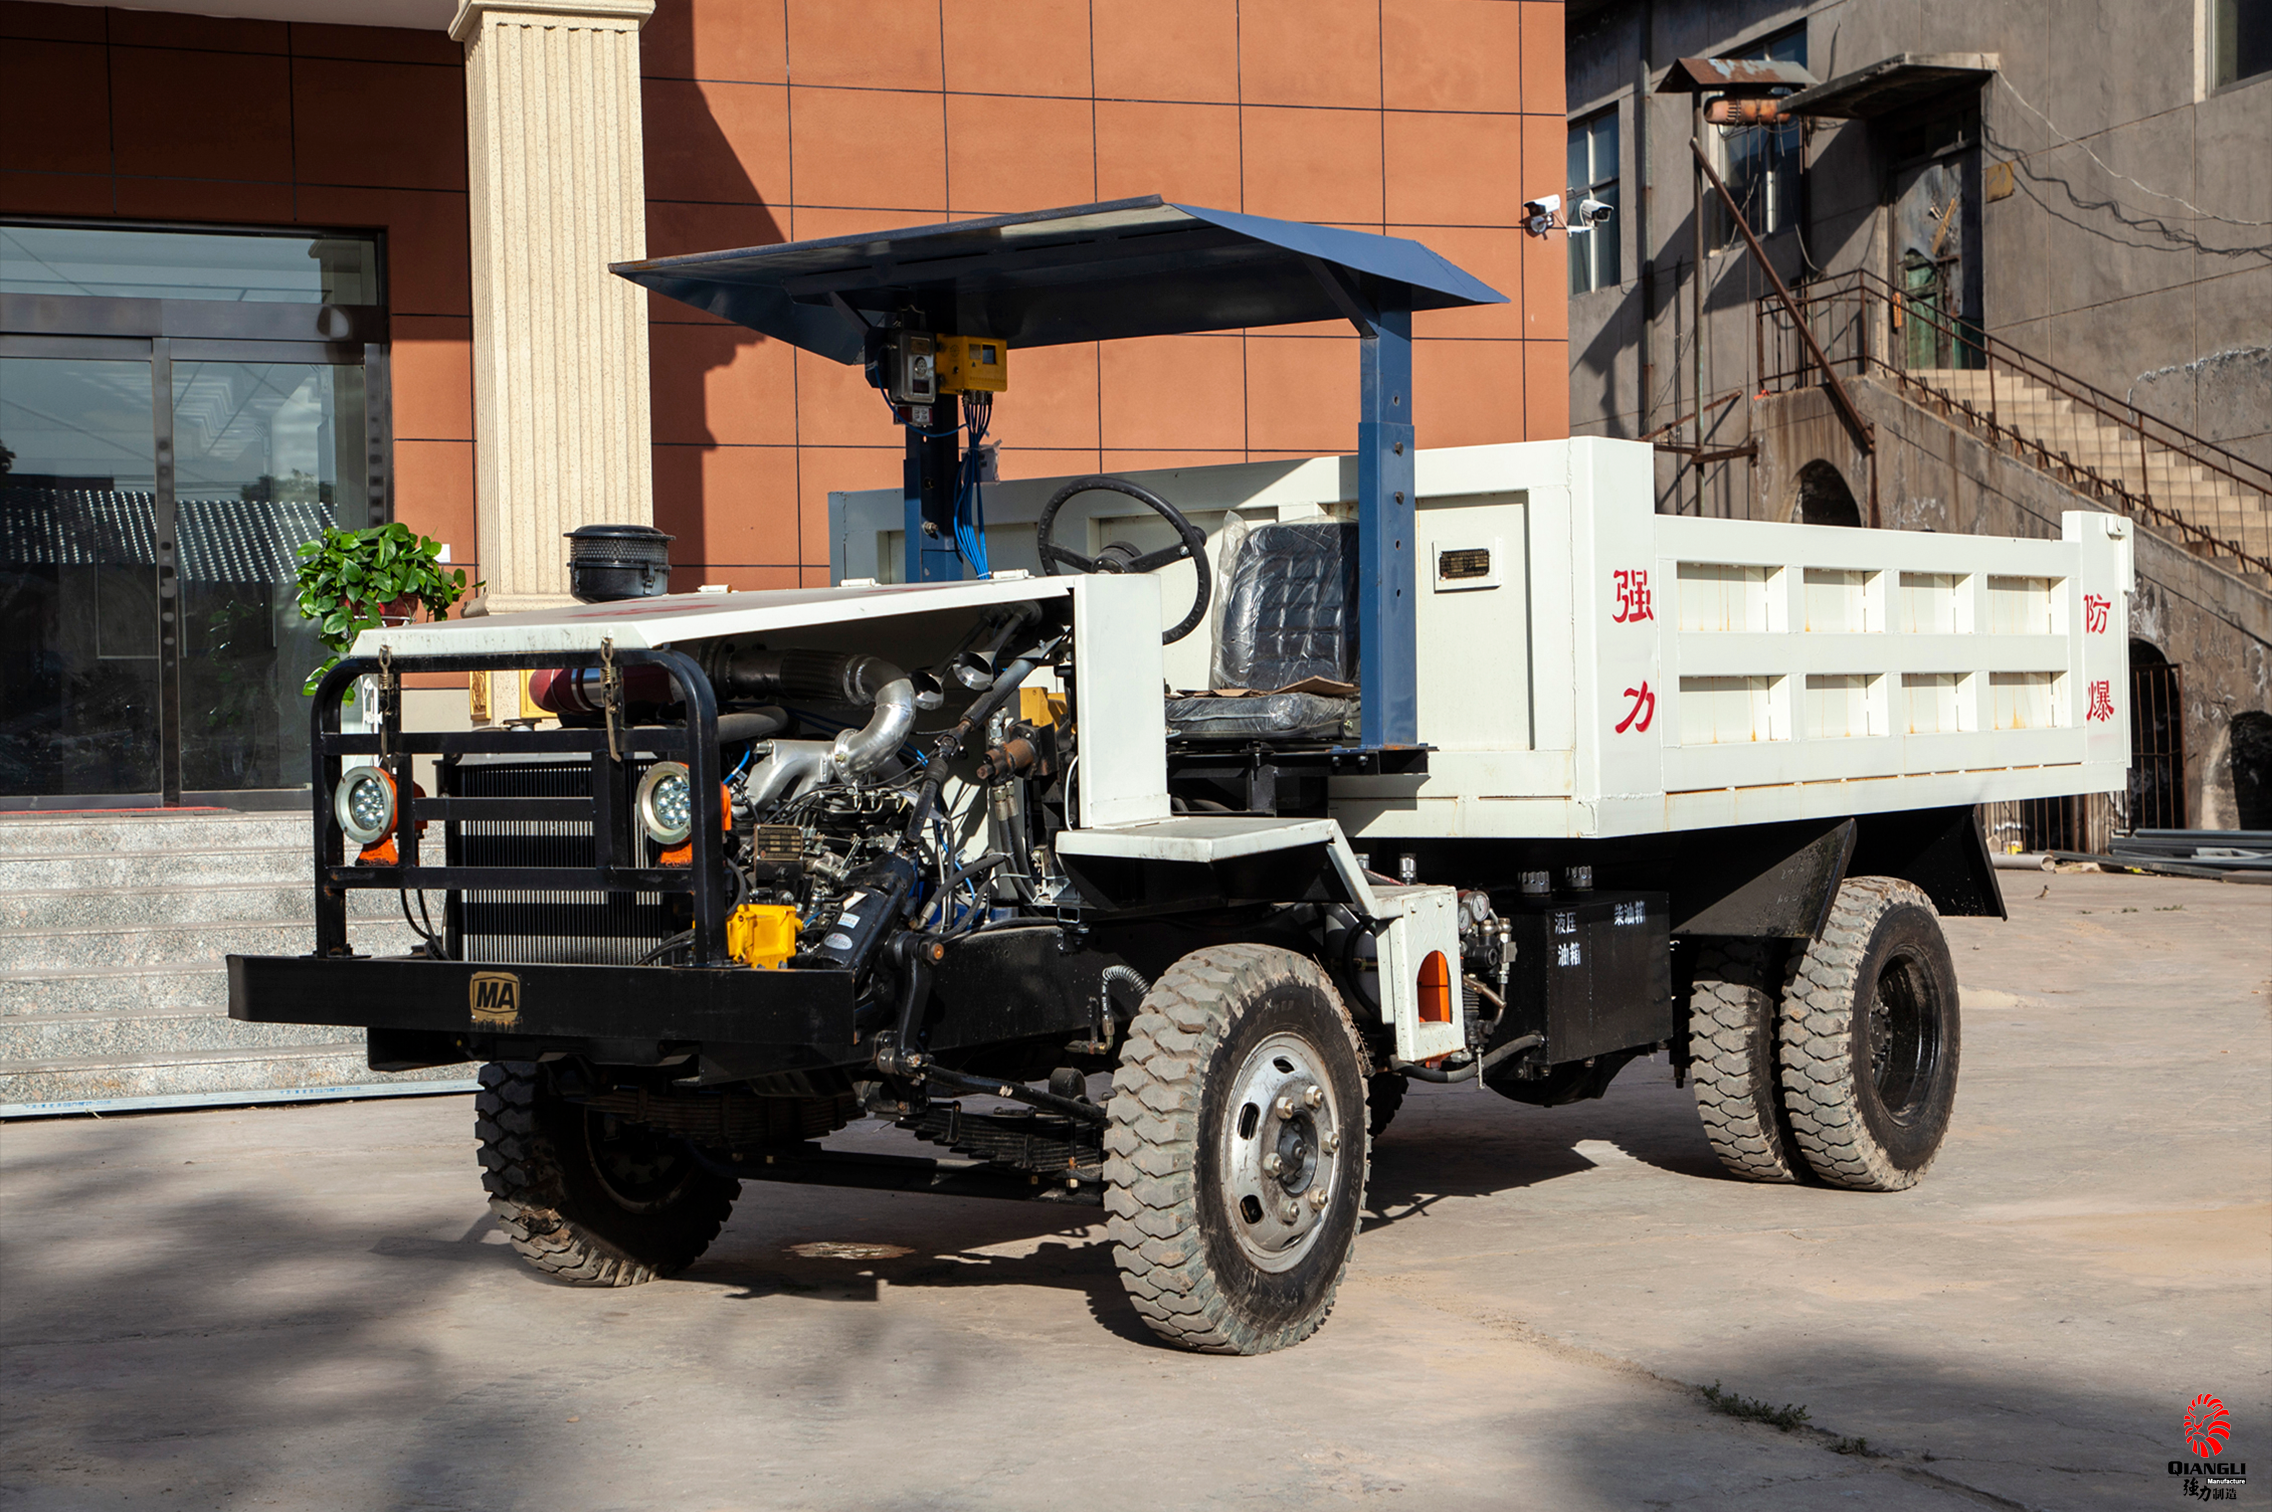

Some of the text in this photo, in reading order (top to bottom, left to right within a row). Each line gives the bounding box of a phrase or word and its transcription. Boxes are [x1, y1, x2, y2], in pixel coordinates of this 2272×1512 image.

[1612, 569, 1655, 734] 强力
[2083, 593, 2114, 722] 防爆
[1554, 912, 1577, 934] 液压
[1614, 900, 1646, 926] 柴油箱
[1558, 942, 1581, 967] 油箱
[476, 982, 515, 1009] MA
